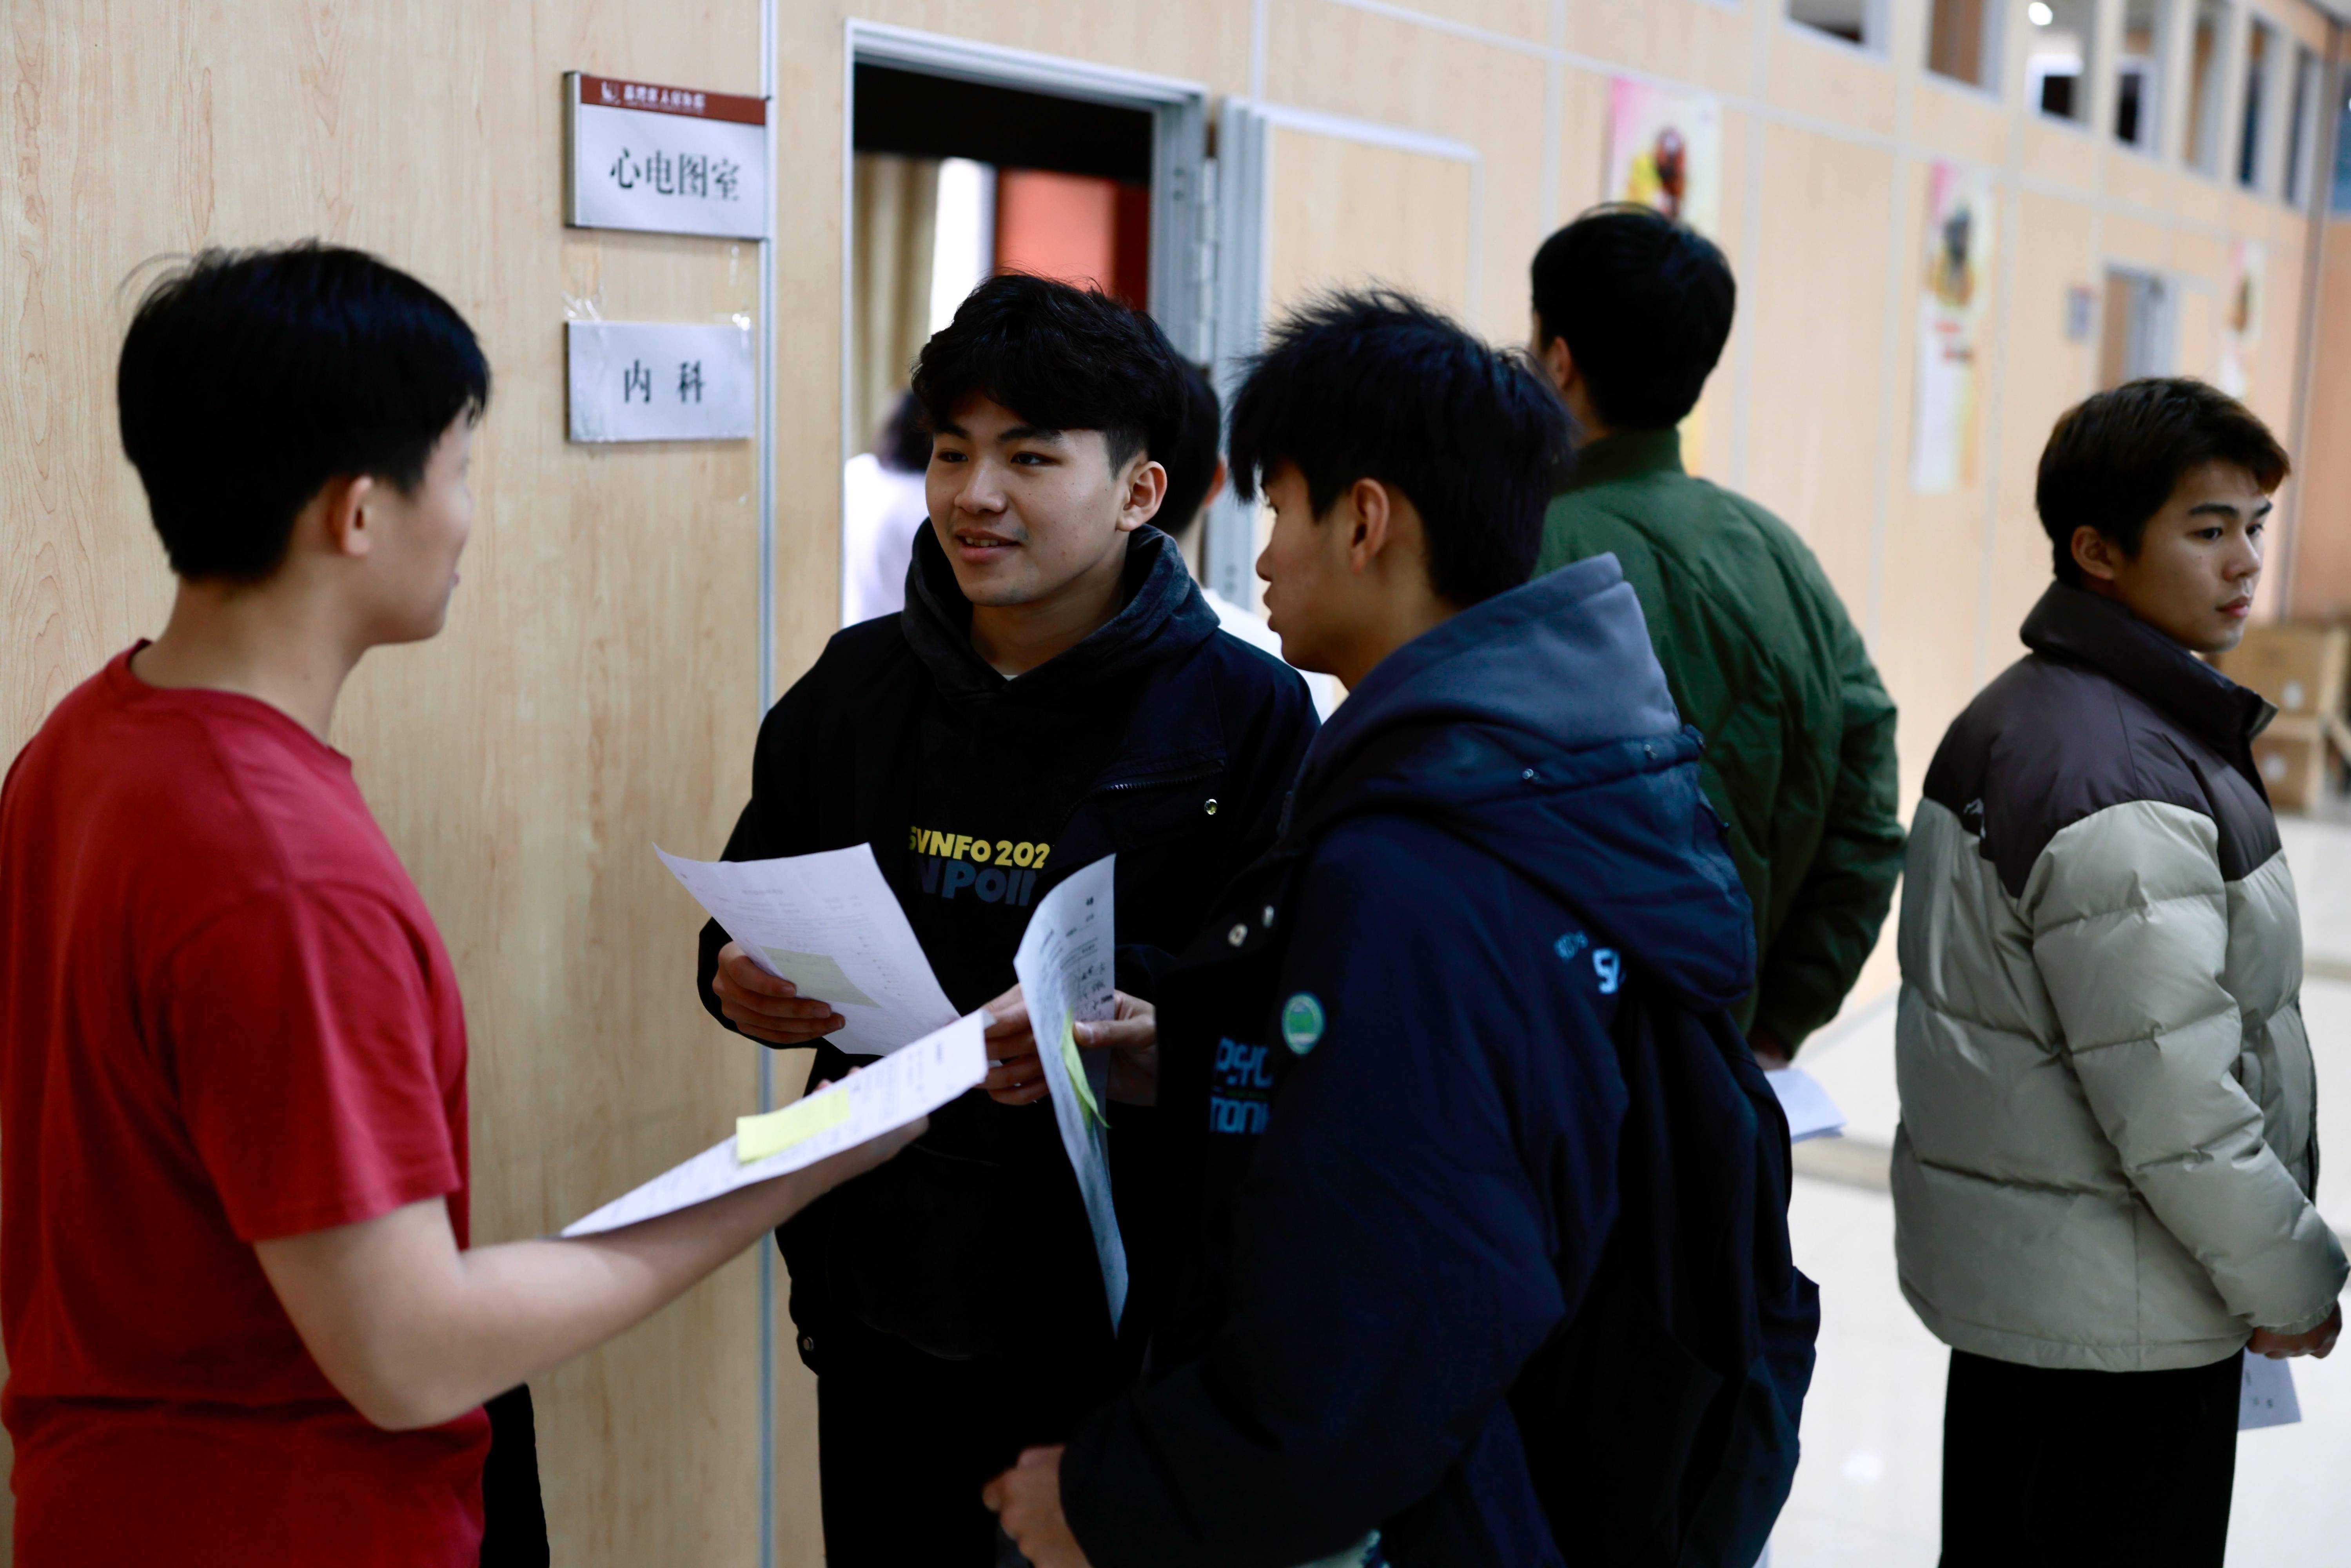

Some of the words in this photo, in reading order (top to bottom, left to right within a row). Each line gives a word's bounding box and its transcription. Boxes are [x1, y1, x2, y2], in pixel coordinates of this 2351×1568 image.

[610, 146, 740, 201] 心电图室
[624, 358, 706, 403] 内科
